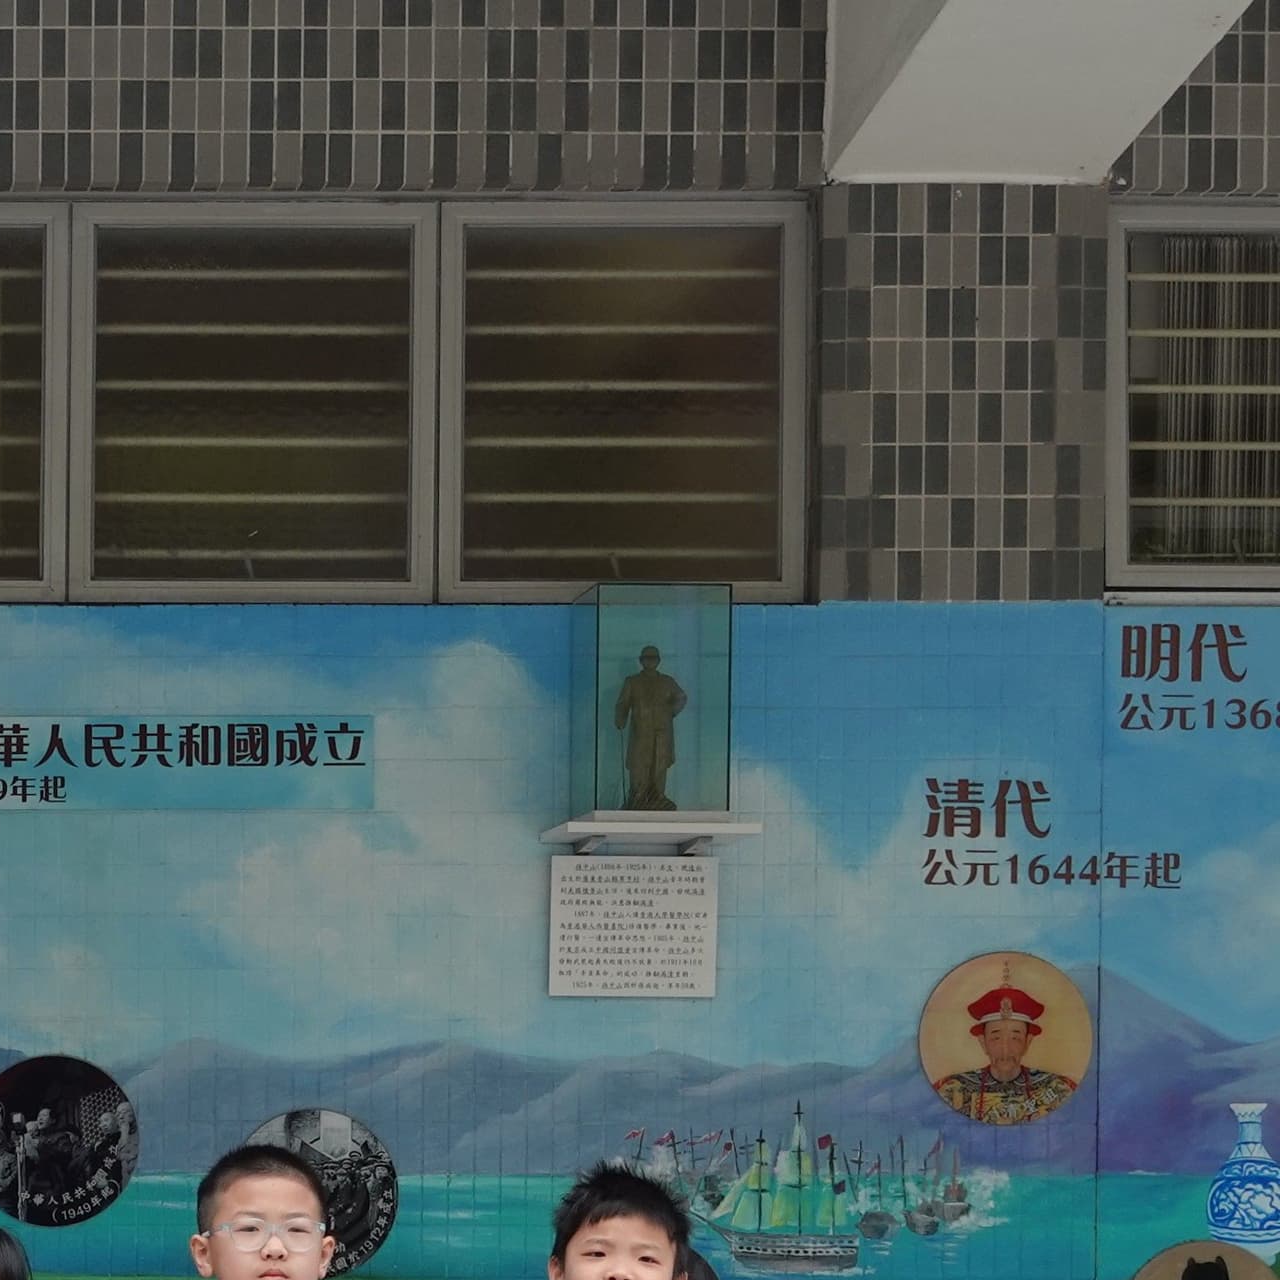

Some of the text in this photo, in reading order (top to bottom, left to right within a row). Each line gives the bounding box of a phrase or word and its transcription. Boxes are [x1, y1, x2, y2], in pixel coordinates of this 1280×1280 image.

[1120, 623, 1248, 683] 明代
[922, 778, 1052, 839] 清代
[921, 849, 1182, 890] 公元1644年起
